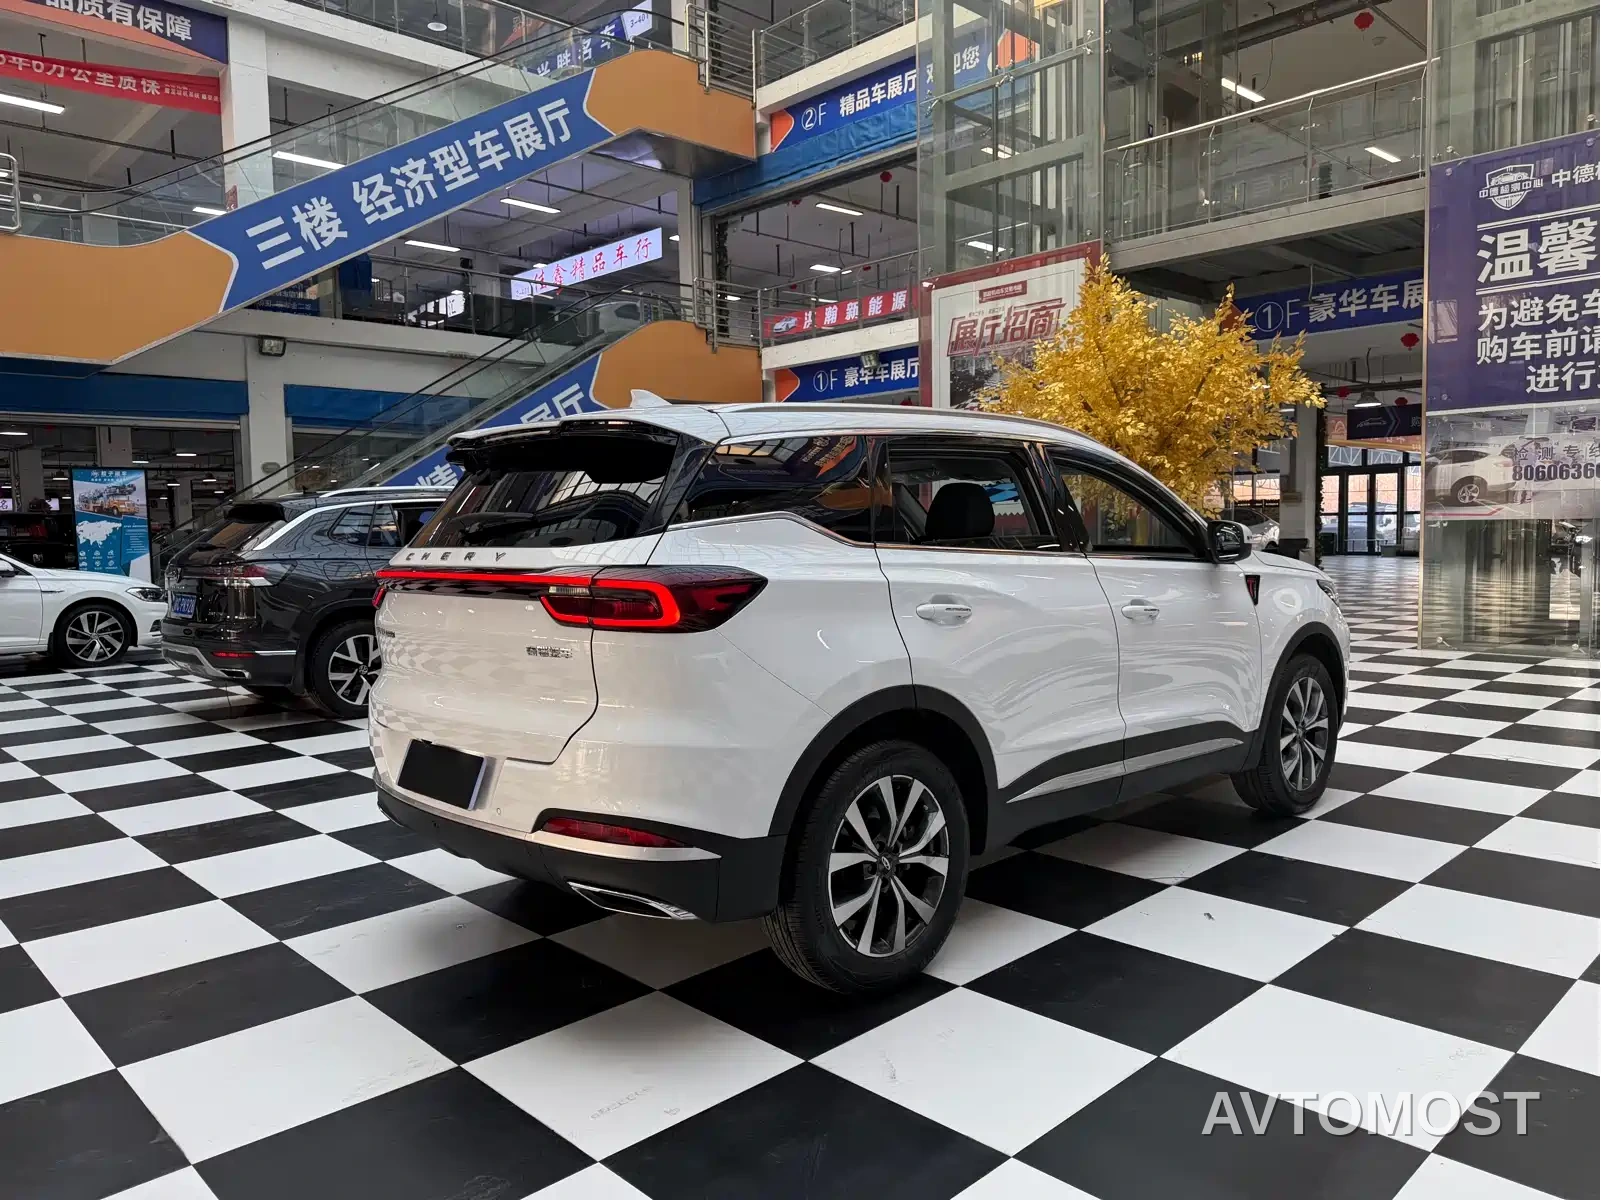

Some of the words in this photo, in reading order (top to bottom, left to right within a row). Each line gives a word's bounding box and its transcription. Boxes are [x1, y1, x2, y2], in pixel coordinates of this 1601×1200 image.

[46, 0, 193, 41] 品质有保障
[839, 69, 917, 117] 精品车展厅
[245, 196, 349, 270] 三楼
[352, 98, 571, 225] 经济型车展厅
[1552, 162, 1600, 188] 中德
[1476, 217, 1598, 283] 温馨
[954, 303, 1067, 357] 展厅招商
[844, 357, 919, 388] 豪华车展厅
[1526, 361, 1600, 393] 进行
[1512, 462, 1600, 481] 8060636
[405, 551, 506, 562] CHERY
